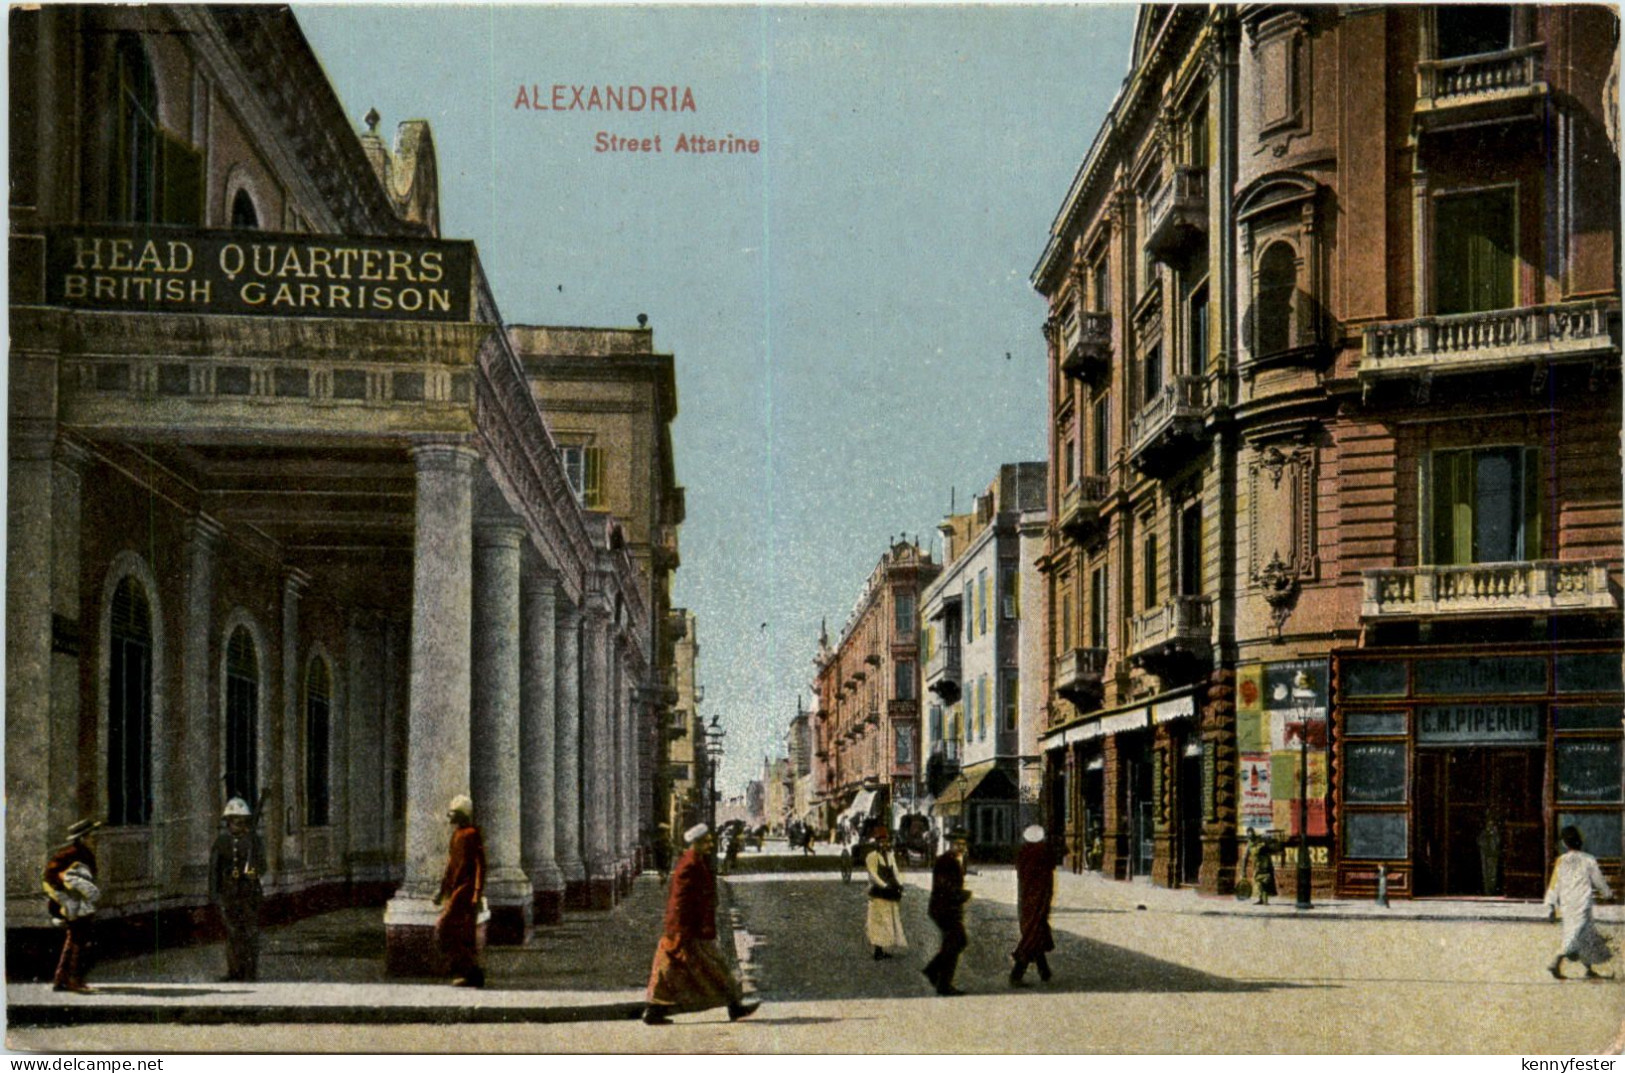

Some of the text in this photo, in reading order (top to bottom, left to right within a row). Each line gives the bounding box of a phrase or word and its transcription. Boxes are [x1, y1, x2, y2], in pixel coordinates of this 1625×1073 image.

[74, 238, 444, 282] HEAD QUARTERS
[64, 276, 451, 312] BRITISH GARRISON
